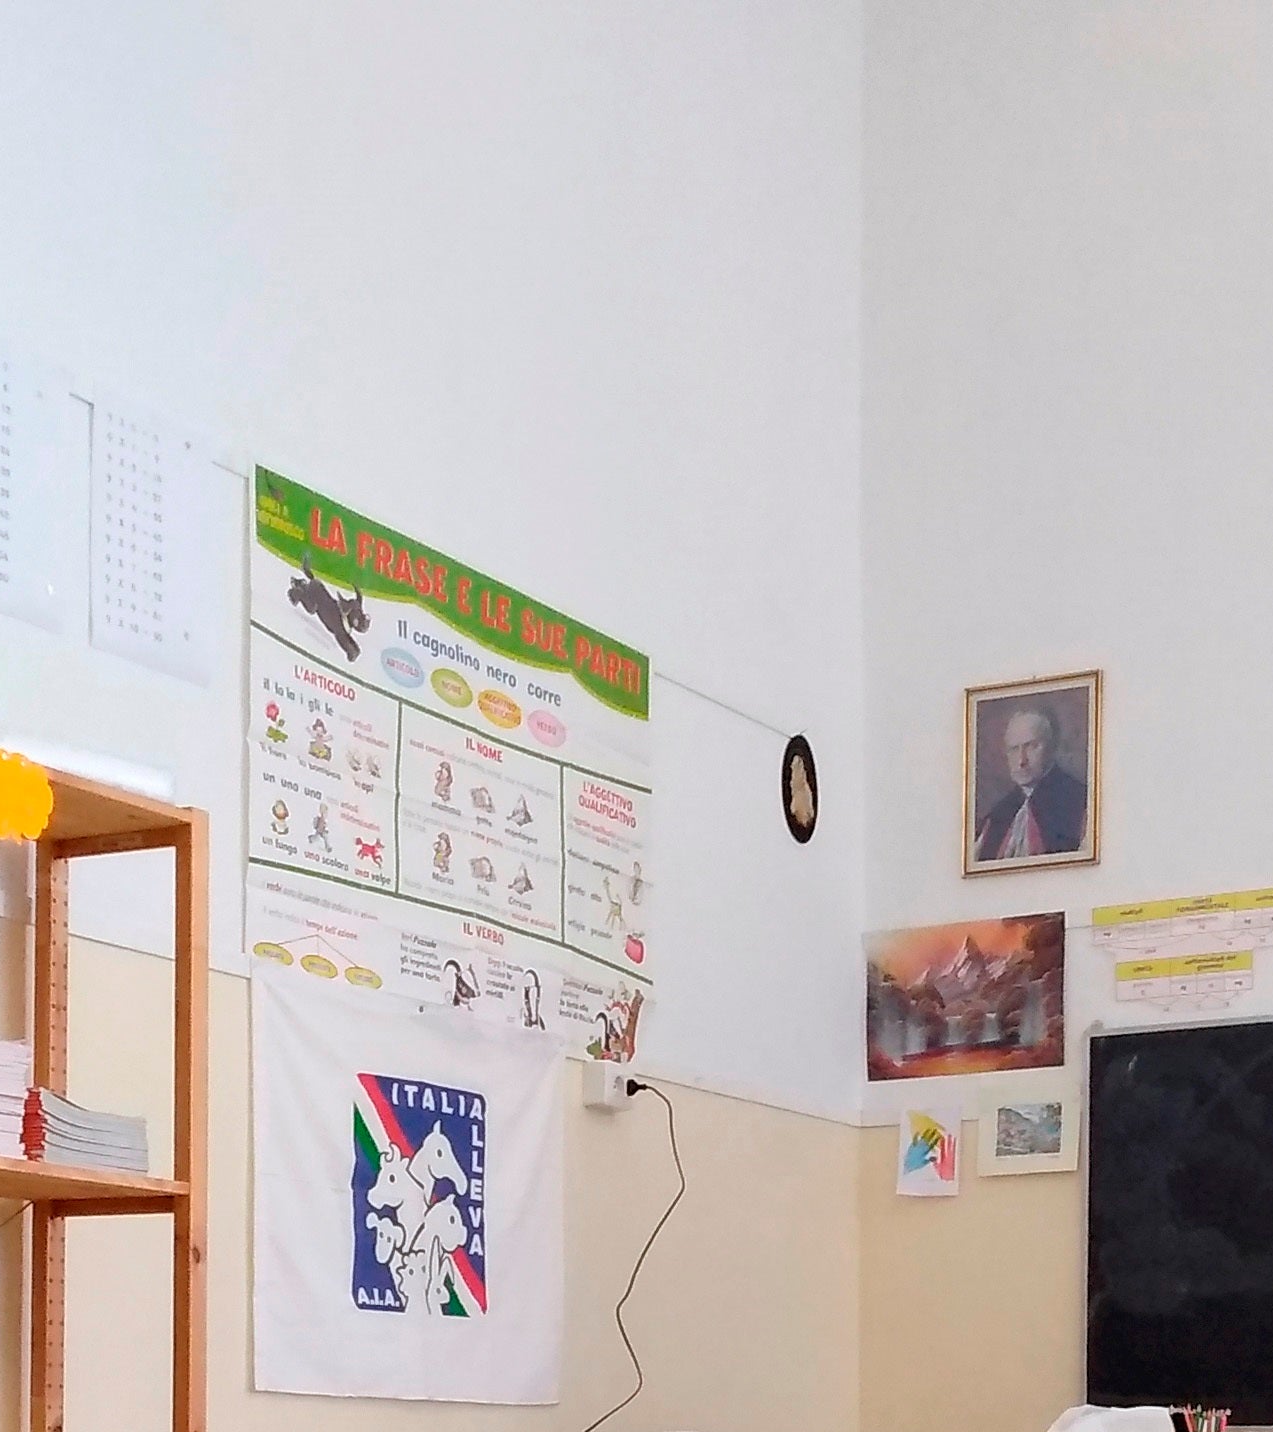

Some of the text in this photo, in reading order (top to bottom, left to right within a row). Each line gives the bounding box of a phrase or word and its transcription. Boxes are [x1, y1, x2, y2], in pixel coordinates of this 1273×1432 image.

[310, 507, 348, 556] LA
[357, 532, 448, 603] FRASE
[457, 576, 472, 615] E
[481, 591, 512, 634] LE
[521, 608, 569, 660] SUE
[574, 635, 641, 695] PARTI
[397, 619, 562, 707] Il cagnolino nero corre
[294, 664, 356, 701] L'ARTICOLO
[465, 737, 503, 763] IL NOME
[262, 772, 275, 783] un
[578, 794, 636, 828] QUALIFICATIVO
[583, 780, 633, 812] L'AGGETTIVO
[463, 922, 504, 945] IL VERBO
[391, 1081, 484, 1121] ITALIA
[356, 1286, 401, 1308] A.I.A.
